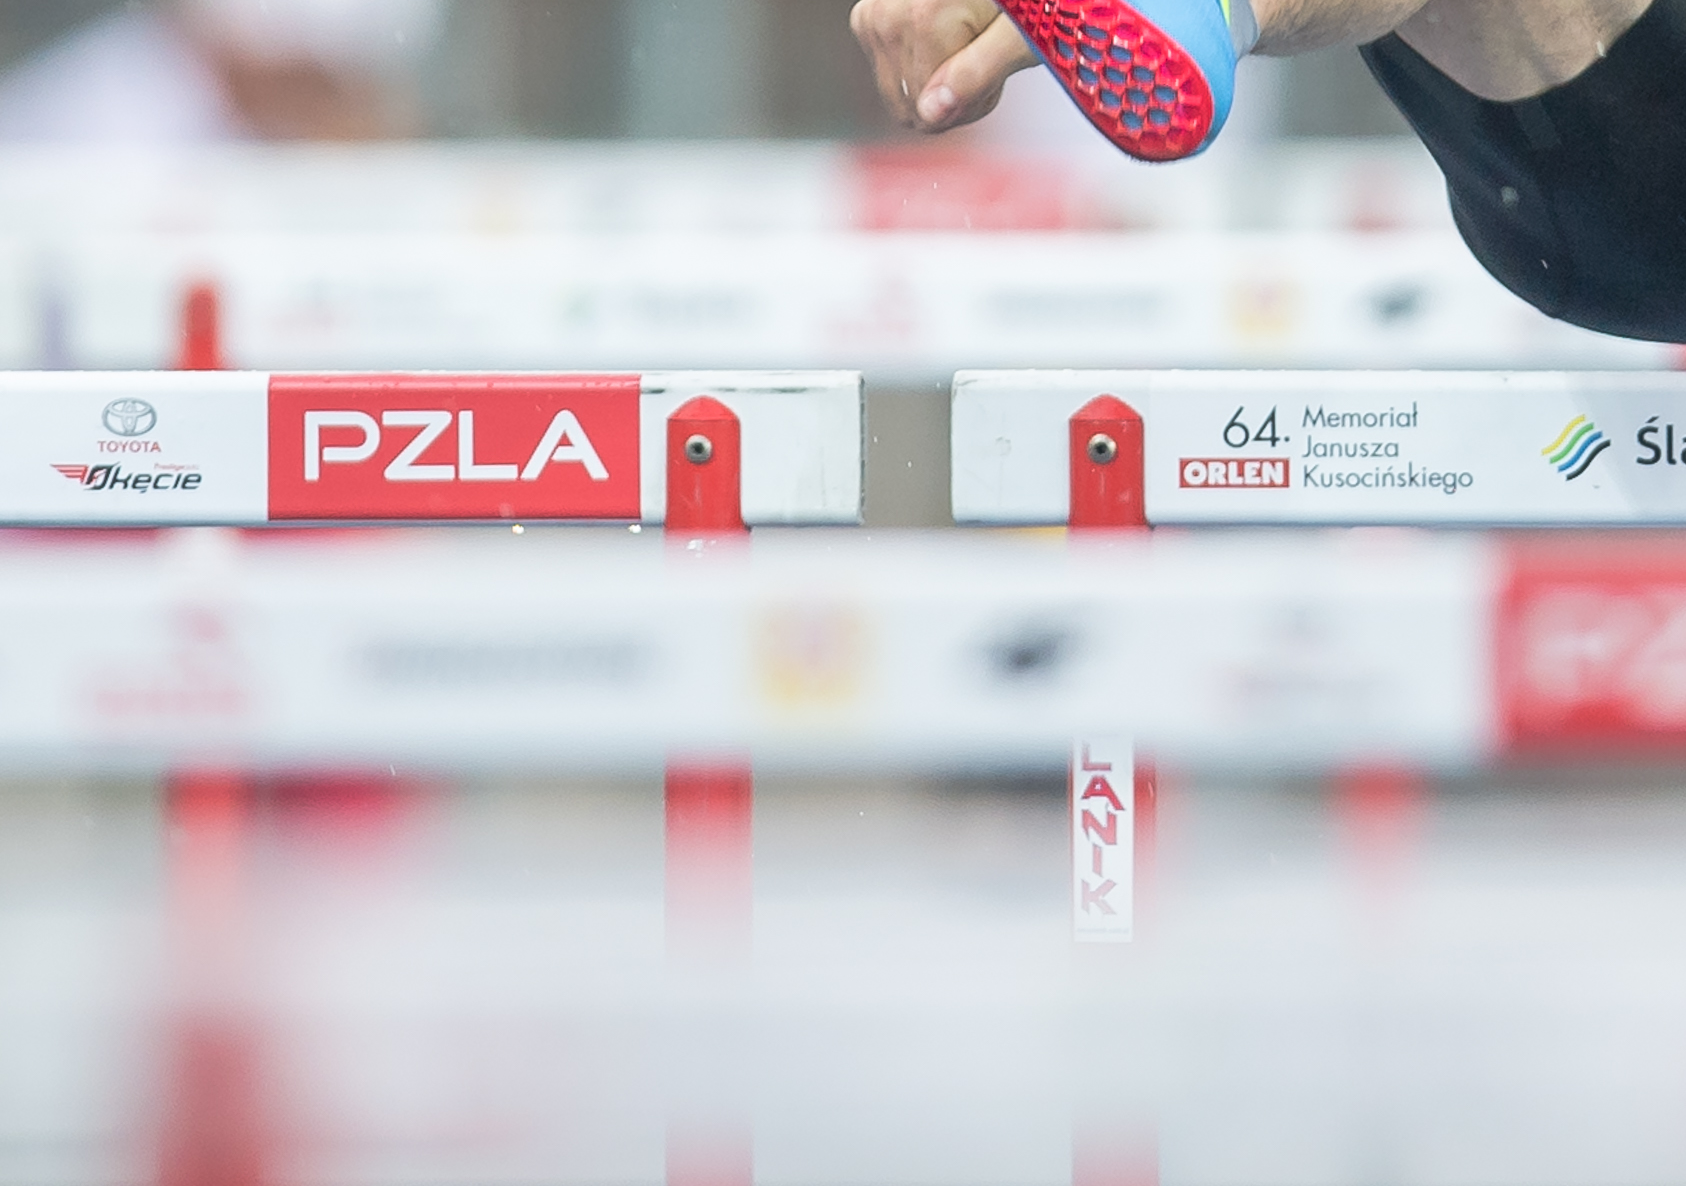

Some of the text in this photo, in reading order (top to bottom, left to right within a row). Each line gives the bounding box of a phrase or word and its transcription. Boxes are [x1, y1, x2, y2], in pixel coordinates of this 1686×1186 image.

[1222, 405, 1291, 448] 64.
[1301, 401, 1419, 428] Memoriał
[97, 440, 162, 453] TOYOTA
[303, 409, 610, 481] PZLA
[1301, 434, 1400, 458] Janusza
[1183, 460, 1285, 486] ORLEN
[1302, 461, 1474, 495] Kusocińskiego
